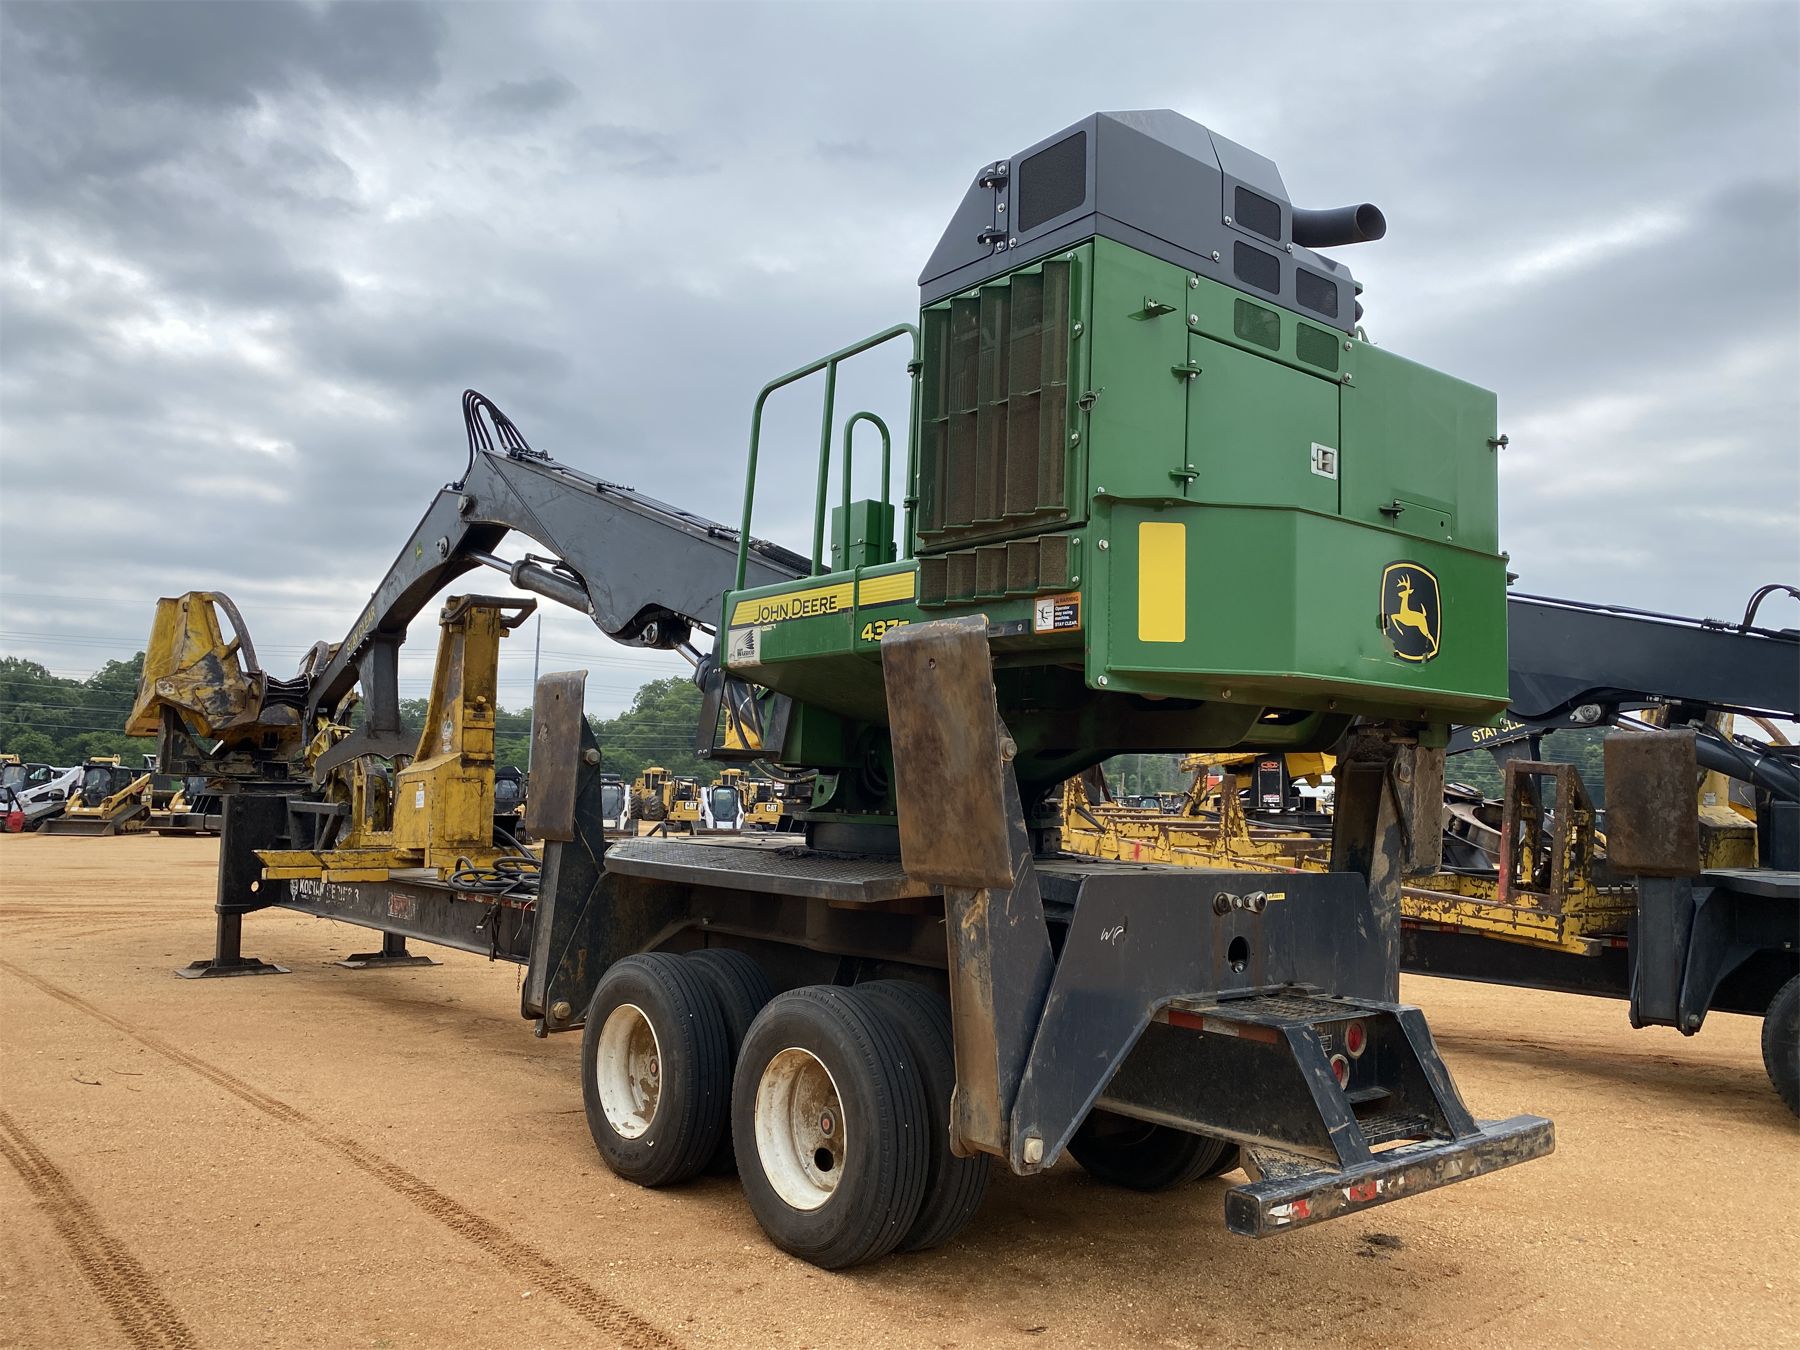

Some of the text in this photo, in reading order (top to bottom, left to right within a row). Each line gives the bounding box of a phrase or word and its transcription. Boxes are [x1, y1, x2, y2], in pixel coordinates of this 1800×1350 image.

[753, 595, 838, 622] JOHN DEERE
[1471, 726, 1498, 743] STAY
[684, 801, 698, 811] CAT
[765, 804, 778, 812] CAT
